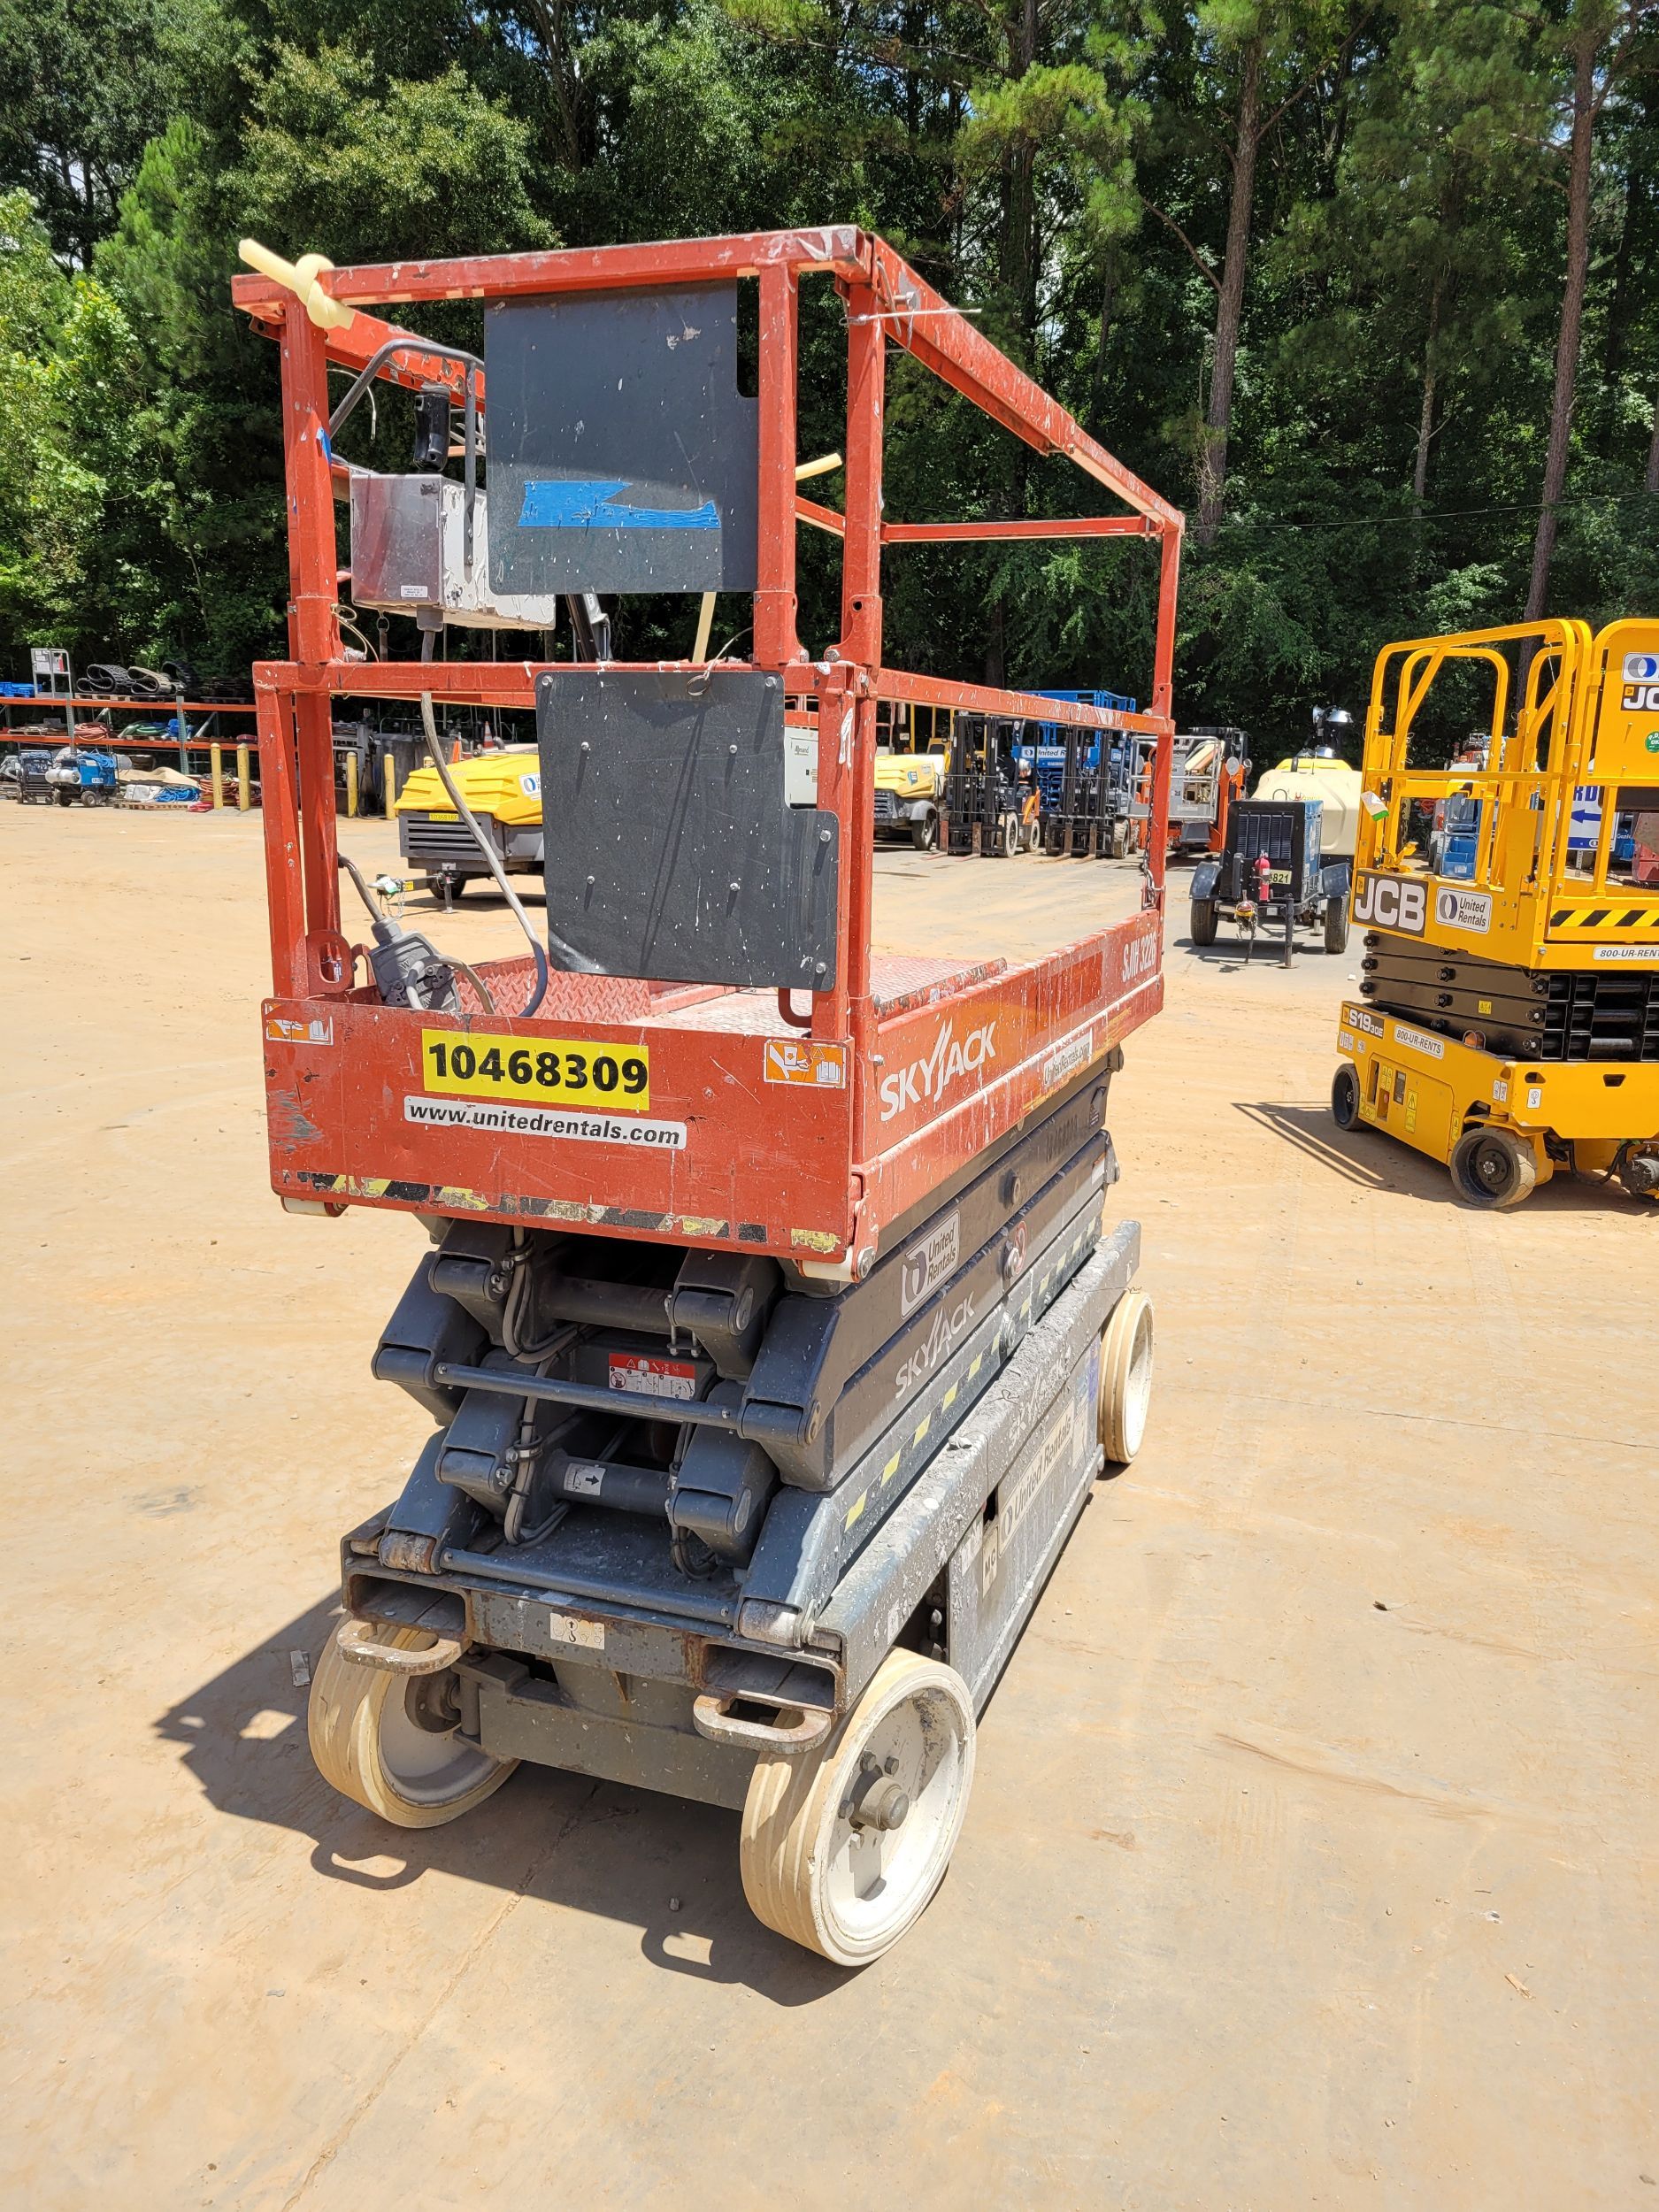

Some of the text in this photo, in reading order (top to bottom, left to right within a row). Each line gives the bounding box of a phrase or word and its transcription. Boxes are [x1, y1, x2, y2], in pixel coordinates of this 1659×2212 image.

[1355, 878, 1425, 932] JCB
[1458, 910, 1486, 927] Rentals
[1459, 897, 1486, 913] United
[1396, 1029, 1441, 1054] 800-UR-RENTS
[428, 1042, 649, 1094] 10468309
[880, 1018, 996, 1122] SKYJACK
[410, 1104, 680, 1145] www.unitedrentals.com
[928, 1222, 956, 1263] United
[927, 1244, 956, 1286] Rentals
[895, 1290, 975, 1400] SKYJACK
[1014, 1417, 1072, 1518] United Rentals
